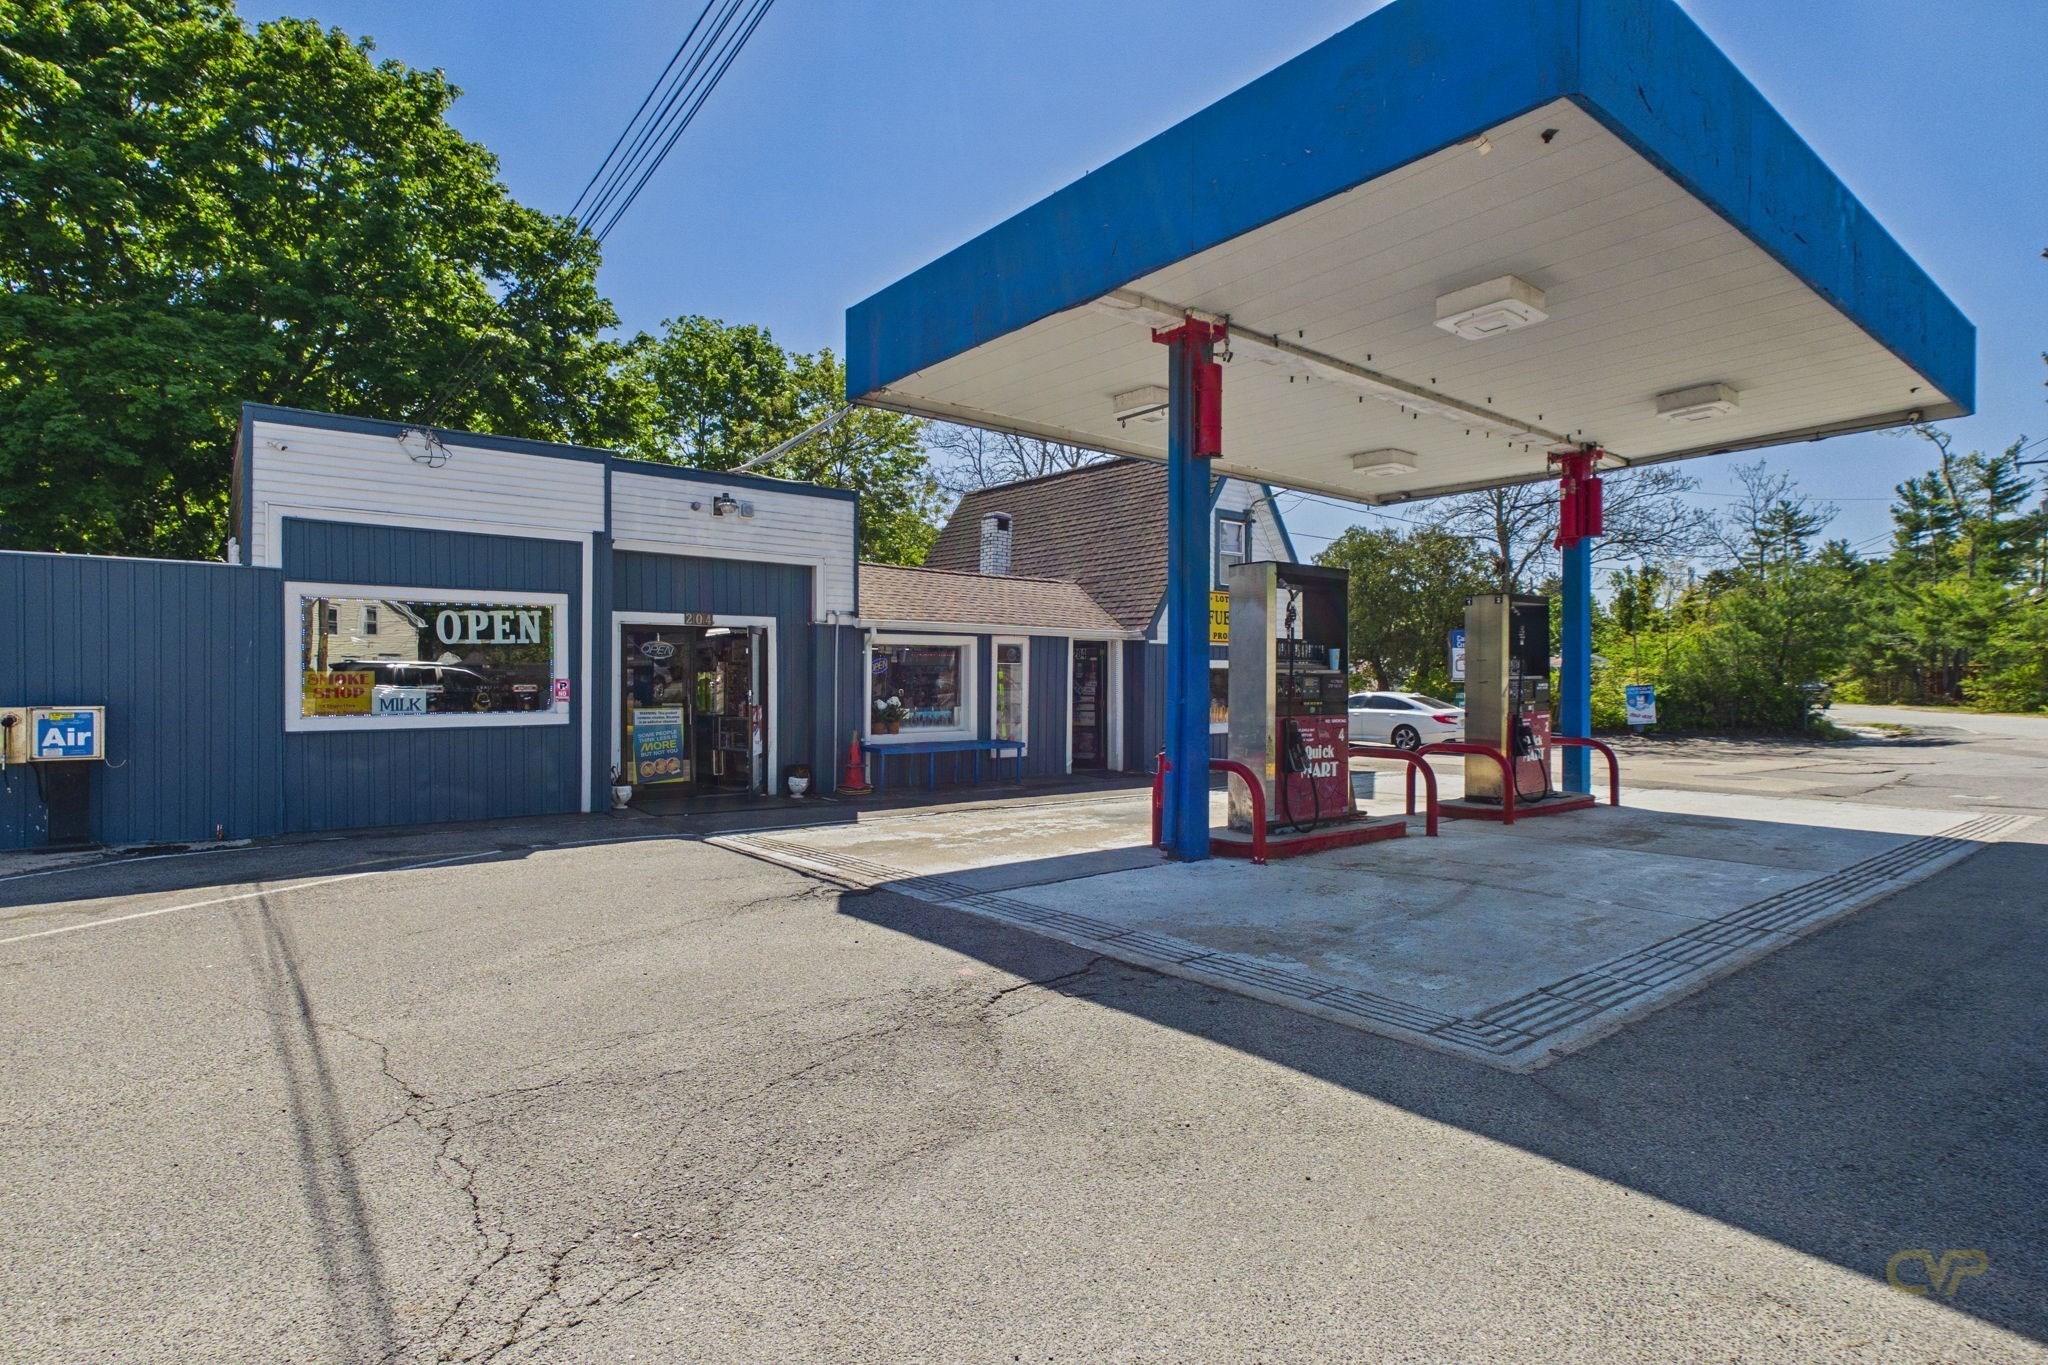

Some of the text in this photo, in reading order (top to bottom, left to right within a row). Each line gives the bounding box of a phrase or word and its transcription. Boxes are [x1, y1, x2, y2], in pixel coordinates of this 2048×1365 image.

[686, 612, 712, 624] 204
[436, 610, 541, 645] OPEN
[642, 644, 674, 655] OPEN
[307, 673, 370, 686] SMOKE
[313, 687, 365, 699] SHOP
[379, 697, 422, 712] MILK
[42, 727, 92, 747] Air
[1338, 727, 1345, 742] 4
[640, 740, 677, 752] MORE
[1305, 744, 1335, 760] Quick
